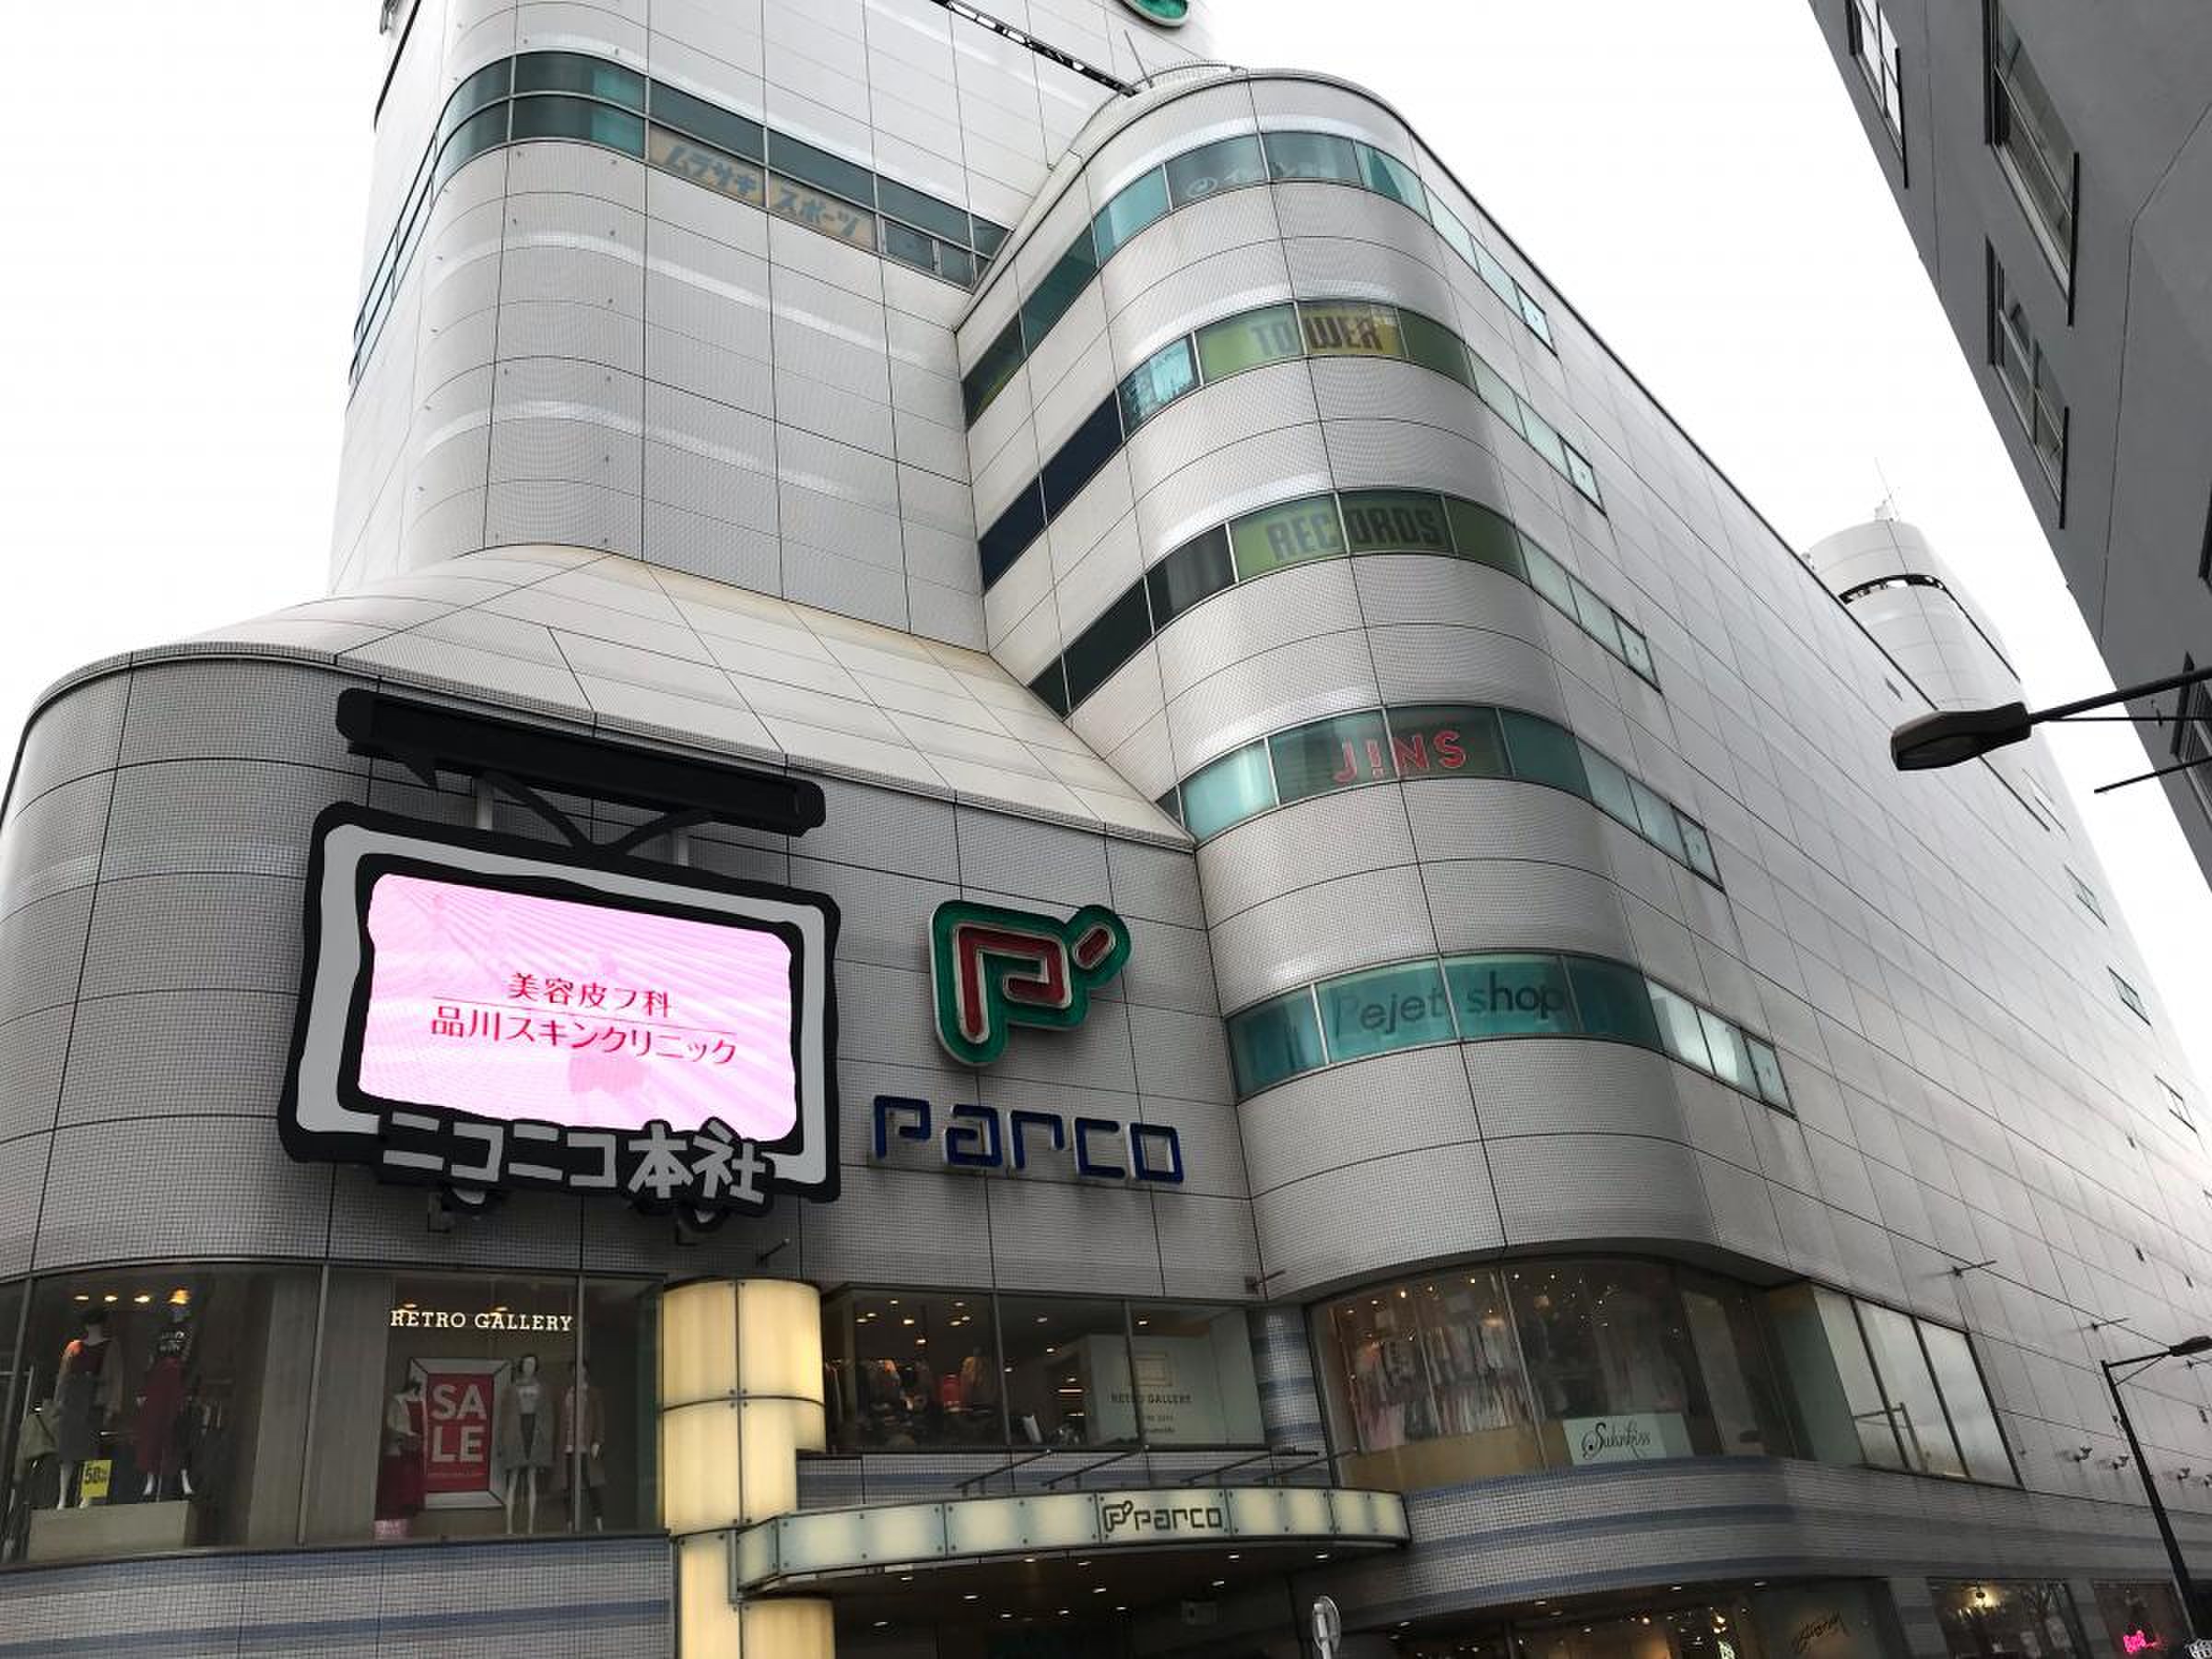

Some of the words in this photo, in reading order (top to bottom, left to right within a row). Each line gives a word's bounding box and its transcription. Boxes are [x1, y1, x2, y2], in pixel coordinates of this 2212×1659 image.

[507, 971, 673, 1018] 美容皮フ科
[1466, 971, 1565, 1019] shop
[430, 1005, 736, 1065] 品川スキンクリニック
[382, 1111, 766, 1205] ニコニコ本社
[390, 1309, 466, 1328] RETRO
[474, 1312, 572, 1332] GALLERY
